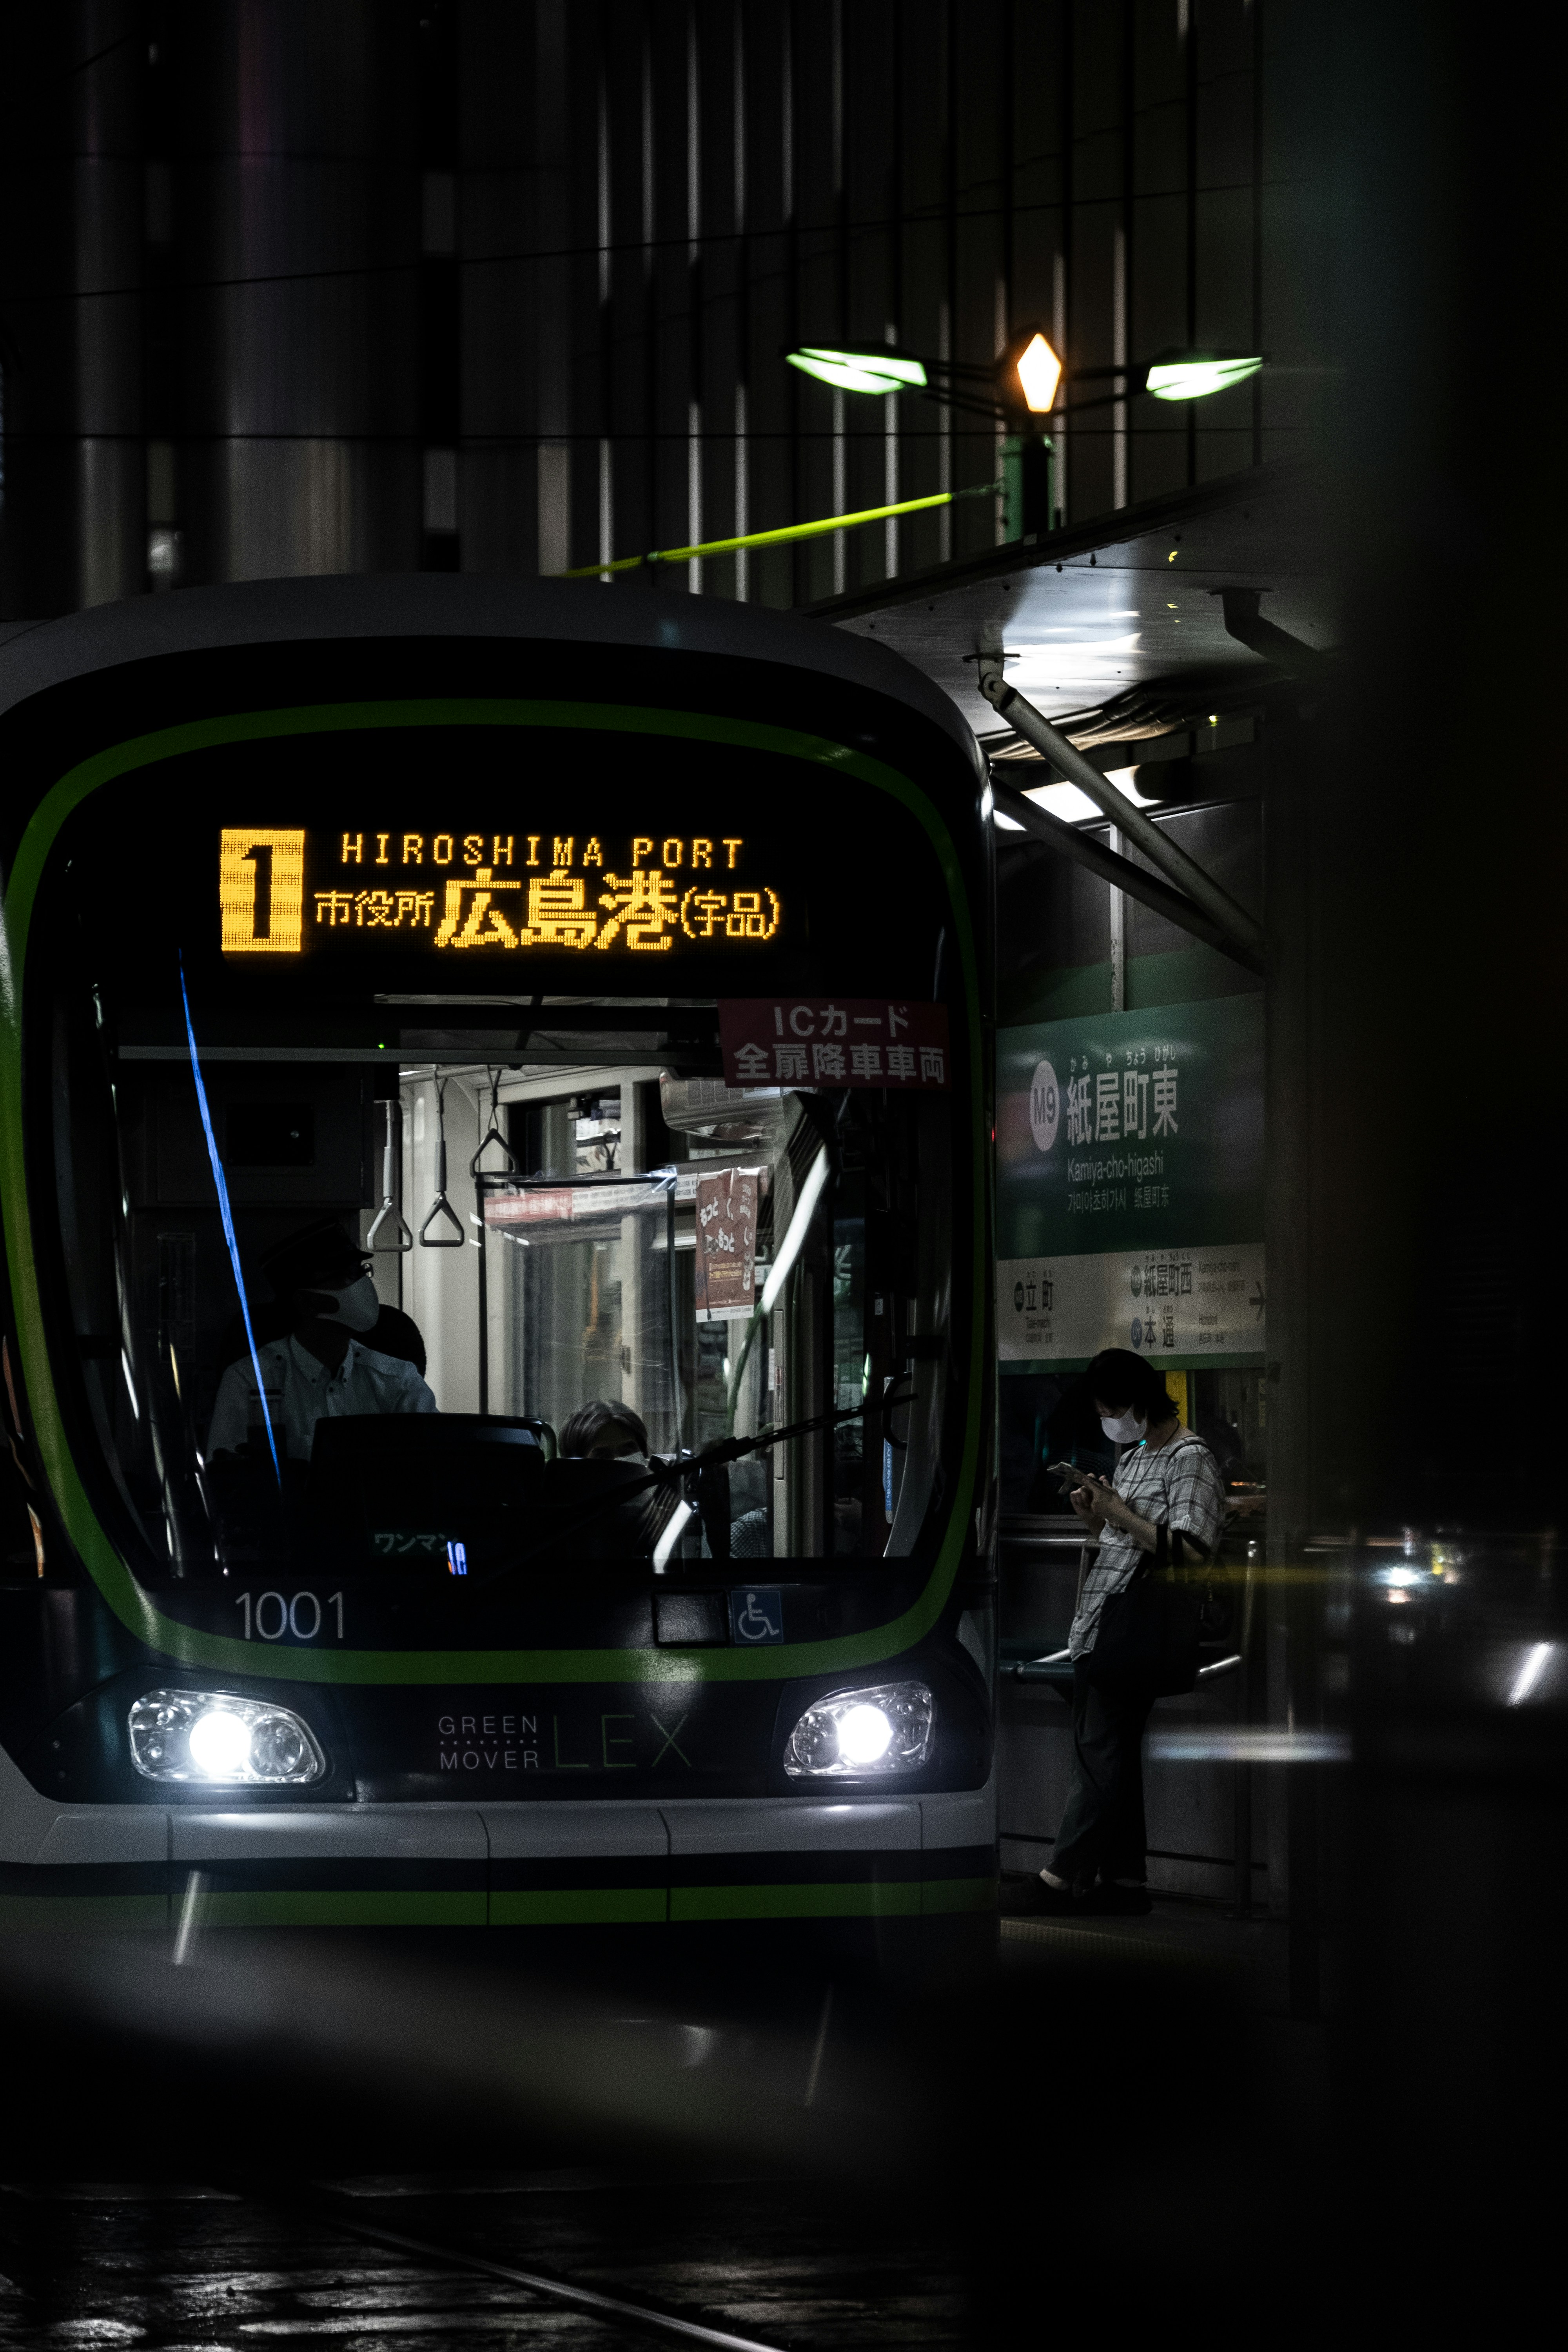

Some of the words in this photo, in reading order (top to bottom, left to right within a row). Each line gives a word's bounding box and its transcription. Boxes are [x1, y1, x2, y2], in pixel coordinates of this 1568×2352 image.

[342, 833, 603, 866] HIROSHIMA
[633, 837, 743, 868] PORT
[314, 890, 434, 926] 市役所
[434, 867, 679, 950] 広島港
[681, 886, 780, 940] (宇品)
[773, 1004, 909, 1038] ICカード
[733, 1042, 945, 1084] 全扉降車車両
[1033, 1086, 1056, 1127] M9
[1067, 1064, 1179, 1147] 紙屋町東
[1067, 1150, 1164, 1187] Kamiya-cho-higashi
[1026, 1279, 1053, 1311] 立町
[1144, 1263, 1192, 1297] 紙屋町西
[1145, 1315, 1175, 1349] 本通
[235, 1591, 344, 1640] 1001
[438, 1715, 537, 1735] GREEN
[553, 1714, 692, 1768] LEX
[440, 1751, 539, 1769] MOVER
